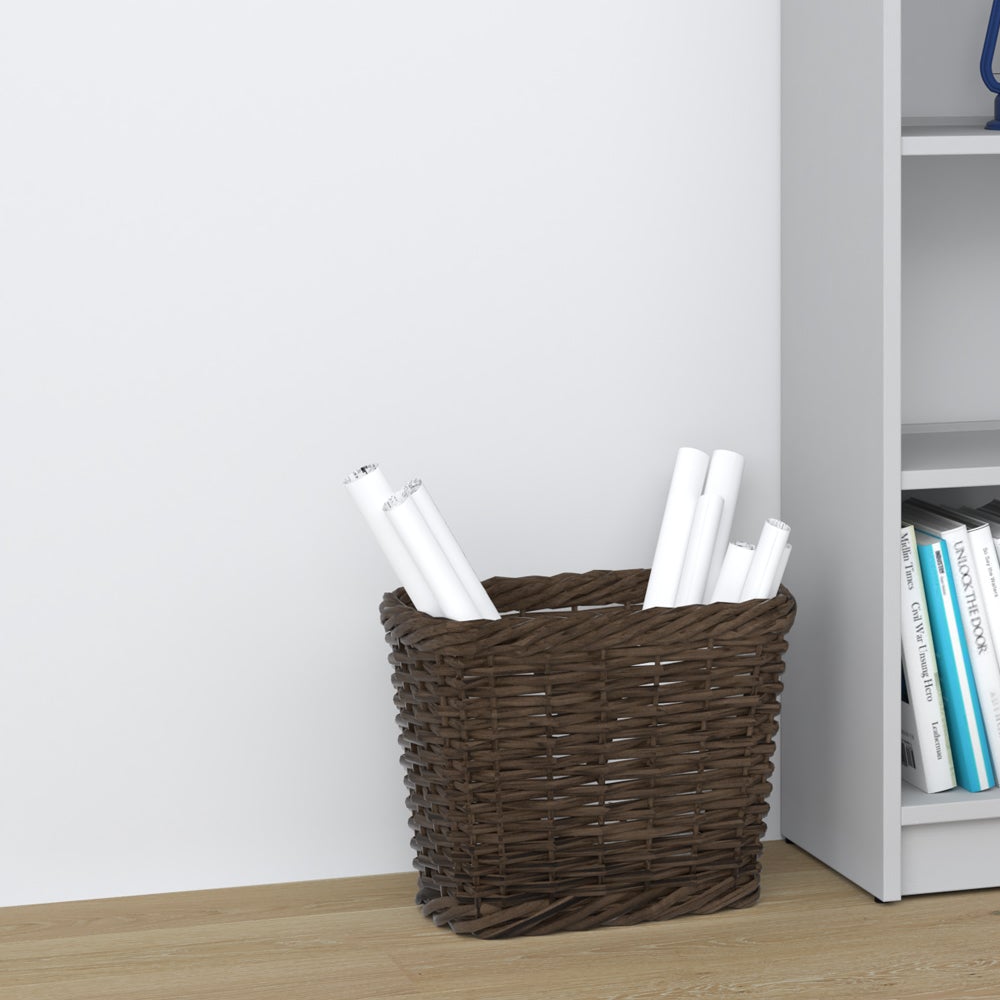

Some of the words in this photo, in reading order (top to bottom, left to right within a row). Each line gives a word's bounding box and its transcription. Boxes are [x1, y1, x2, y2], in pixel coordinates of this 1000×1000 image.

[905, 562, 914, 590] Times
[953, 540, 973, 592] UNLOCK
[911, 602, 922, 622] Civil
[965, 590, 980, 616] THE
[916, 622, 925, 642] War
[971, 617, 987, 655] DOOR
[919, 644, 929, 678] Unsung
[924, 679, 933, 702] Hero
[931, 721, 942, 760] Leatherman
